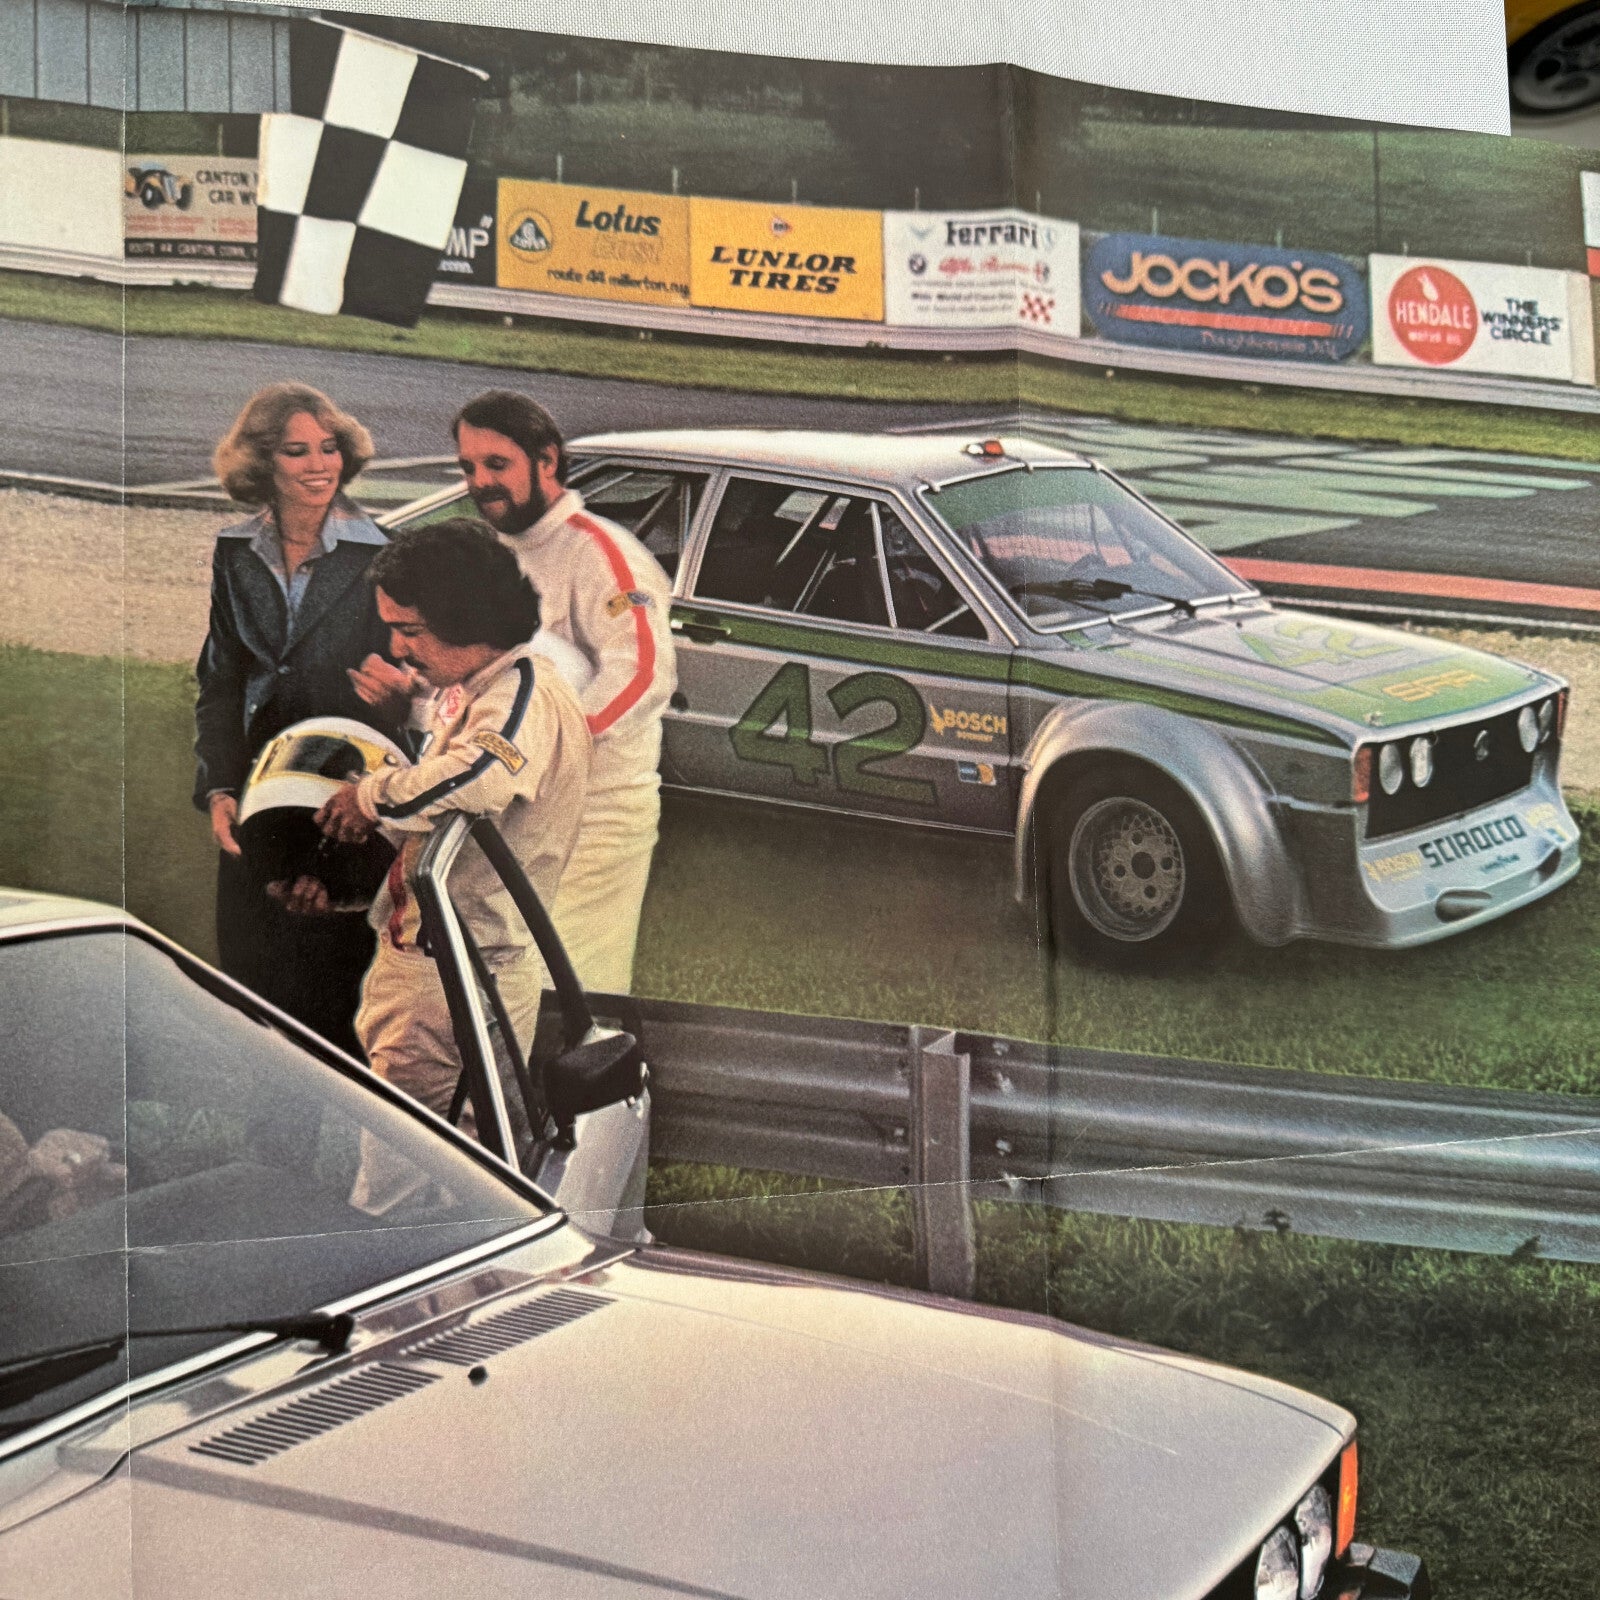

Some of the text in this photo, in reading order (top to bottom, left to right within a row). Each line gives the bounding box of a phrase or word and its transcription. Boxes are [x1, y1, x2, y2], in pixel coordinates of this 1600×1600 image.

[195, 169, 250, 187] CANTON
[209, 189, 235, 205] CAR
[575, 200, 661, 236] Lotus
[945, 216, 1038, 248] Ferrari
[710, 246, 857, 274] LUNLOR
[547, 267, 582, 283] route
[586, 268, 606, 283] 44
[729, 268, 840, 294] TIRES
[1101, 251, 1343, 313] JOCKO'S
[1395, 299, 1473, 330] HENDALE
[1504, 297, 1538, 316] THE
[1490, 326, 1552, 345] CIRCLE
[728, 661, 938, 807] 42
[943, 708, 1007, 735] BOSCH
[1418, 814, 1527, 868] SCIROCCO
